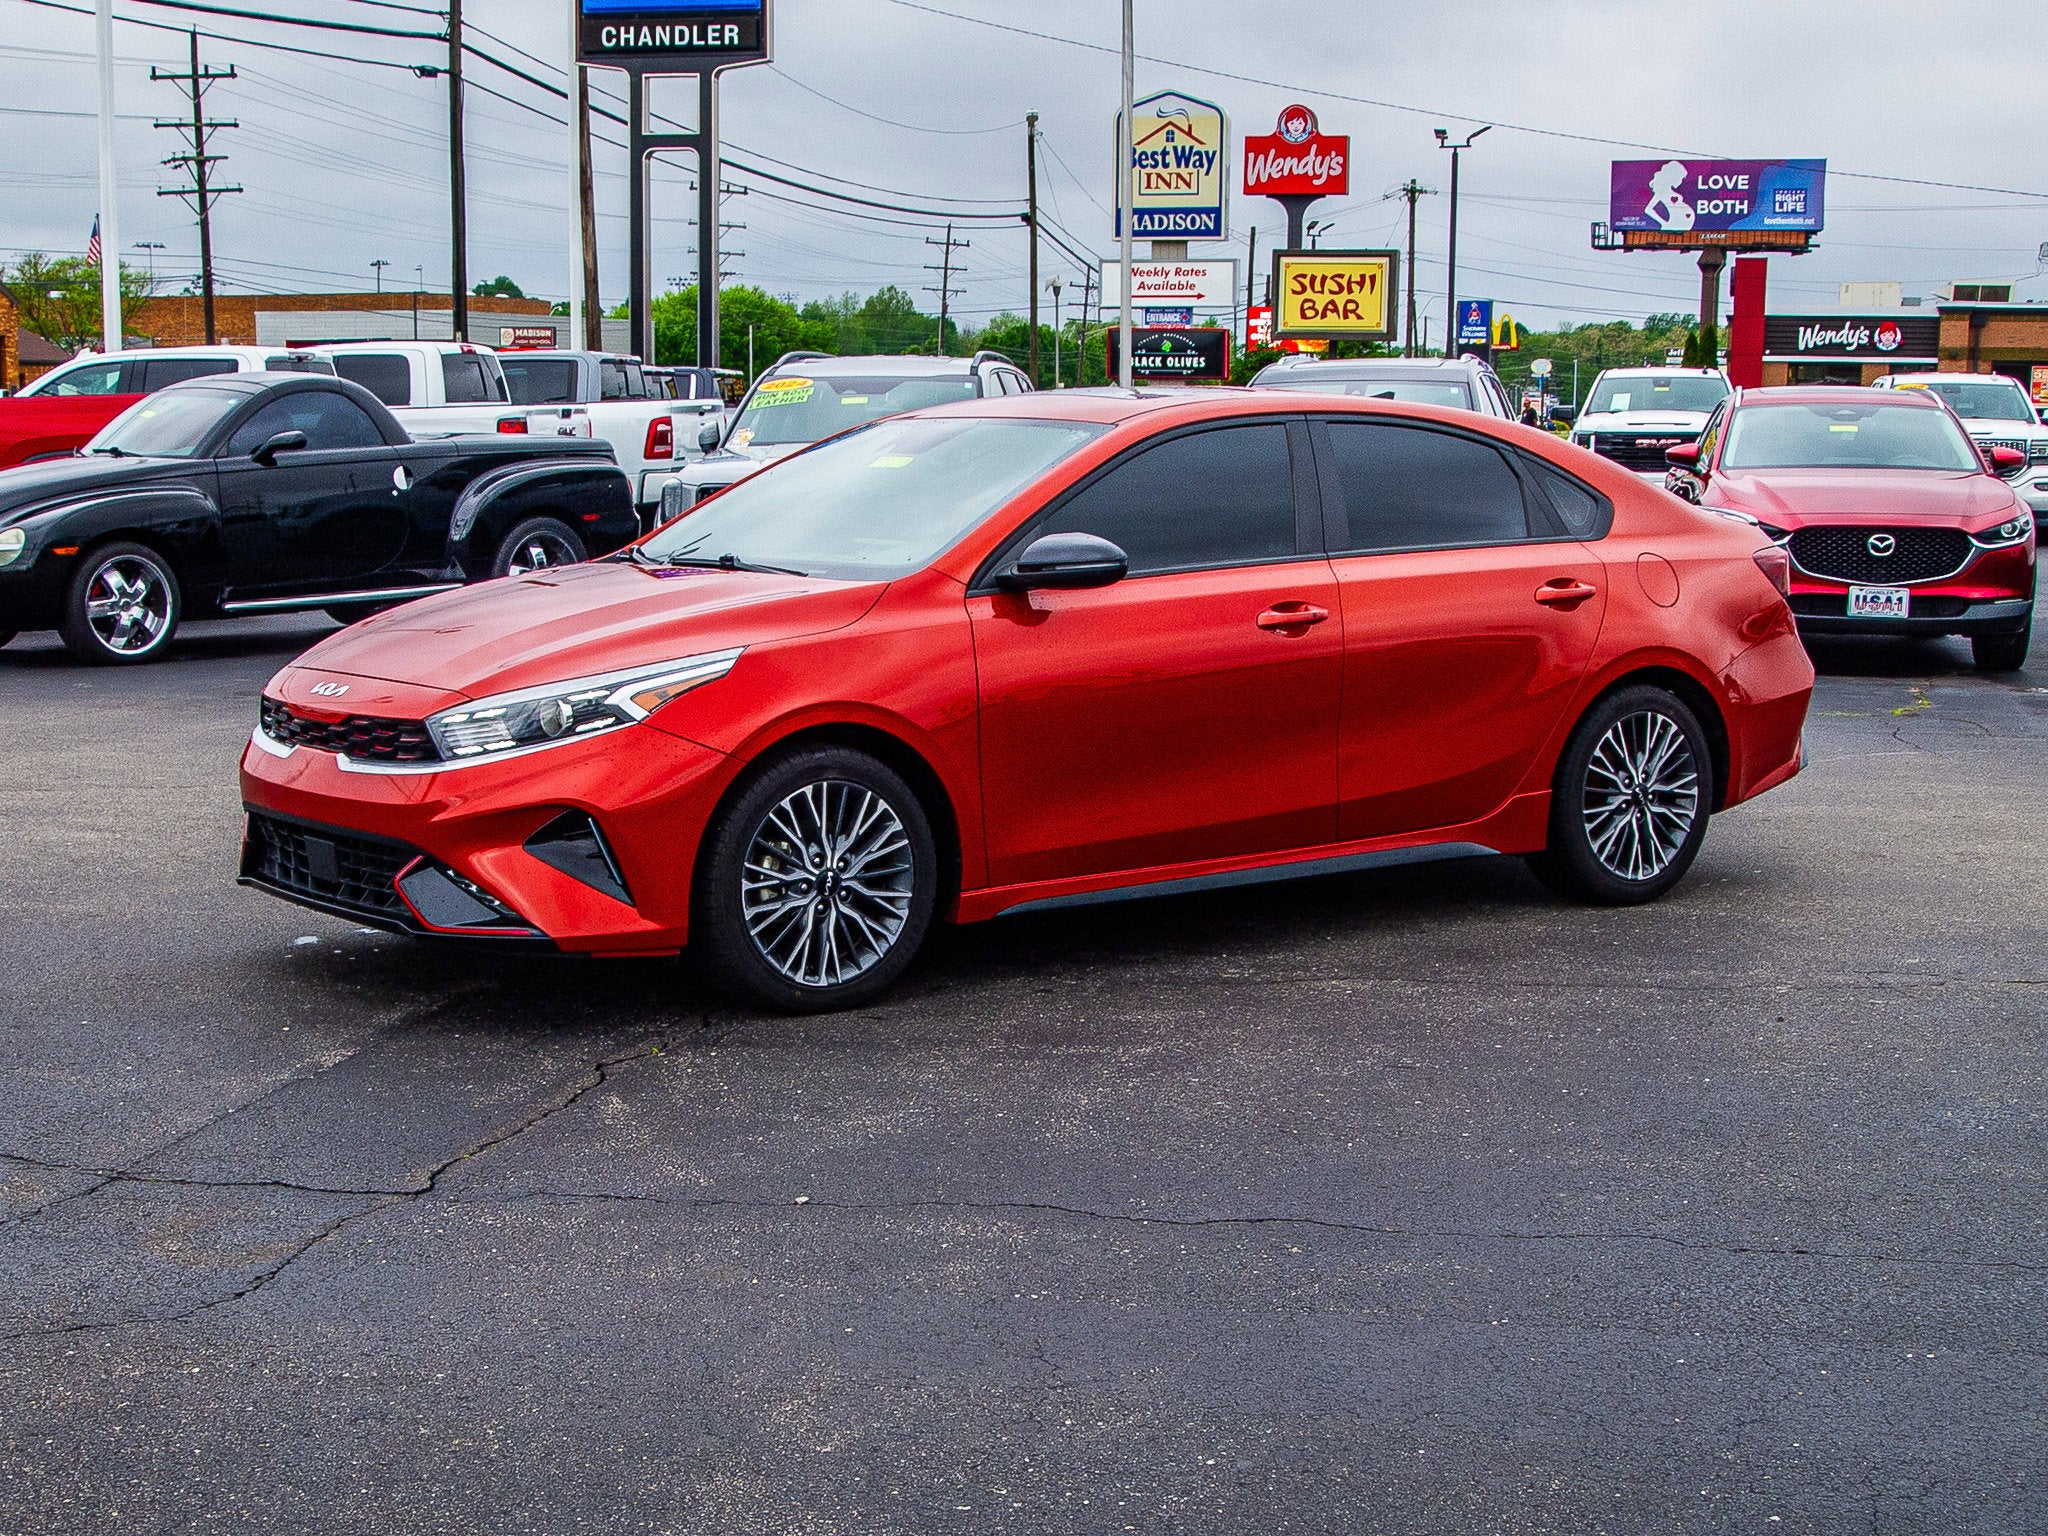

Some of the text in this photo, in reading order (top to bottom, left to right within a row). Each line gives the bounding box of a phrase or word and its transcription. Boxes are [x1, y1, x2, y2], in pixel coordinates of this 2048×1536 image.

[601, 24, 739, 48] CHANDLER
[1172, 145, 1217, 176] Way
[1247, 144, 1344, 186] Wendy's
[1144, 172, 1194, 190] INN
[1697, 175, 1750, 190] LOVE
[1775, 194, 1806, 202] RIGHT
[1696, 200, 1749, 215] BOTH
[1775, 202, 1806, 213] LIFE
[1174, 267, 1207, 278] Rates
[1137, 281, 1196, 291] Available
[1290, 273, 1377, 295] SUSHI
[1299, 298, 1365, 320] BAR
[1146, 313, 1181, 323] ENTRANCE
[515, 329, 552, 337] MADISON
[1798, 321, 1870, 351] Wendy's
[1166, 356, 1206, 368] OLIVES
[783, 387, 812, 397] ROOF
